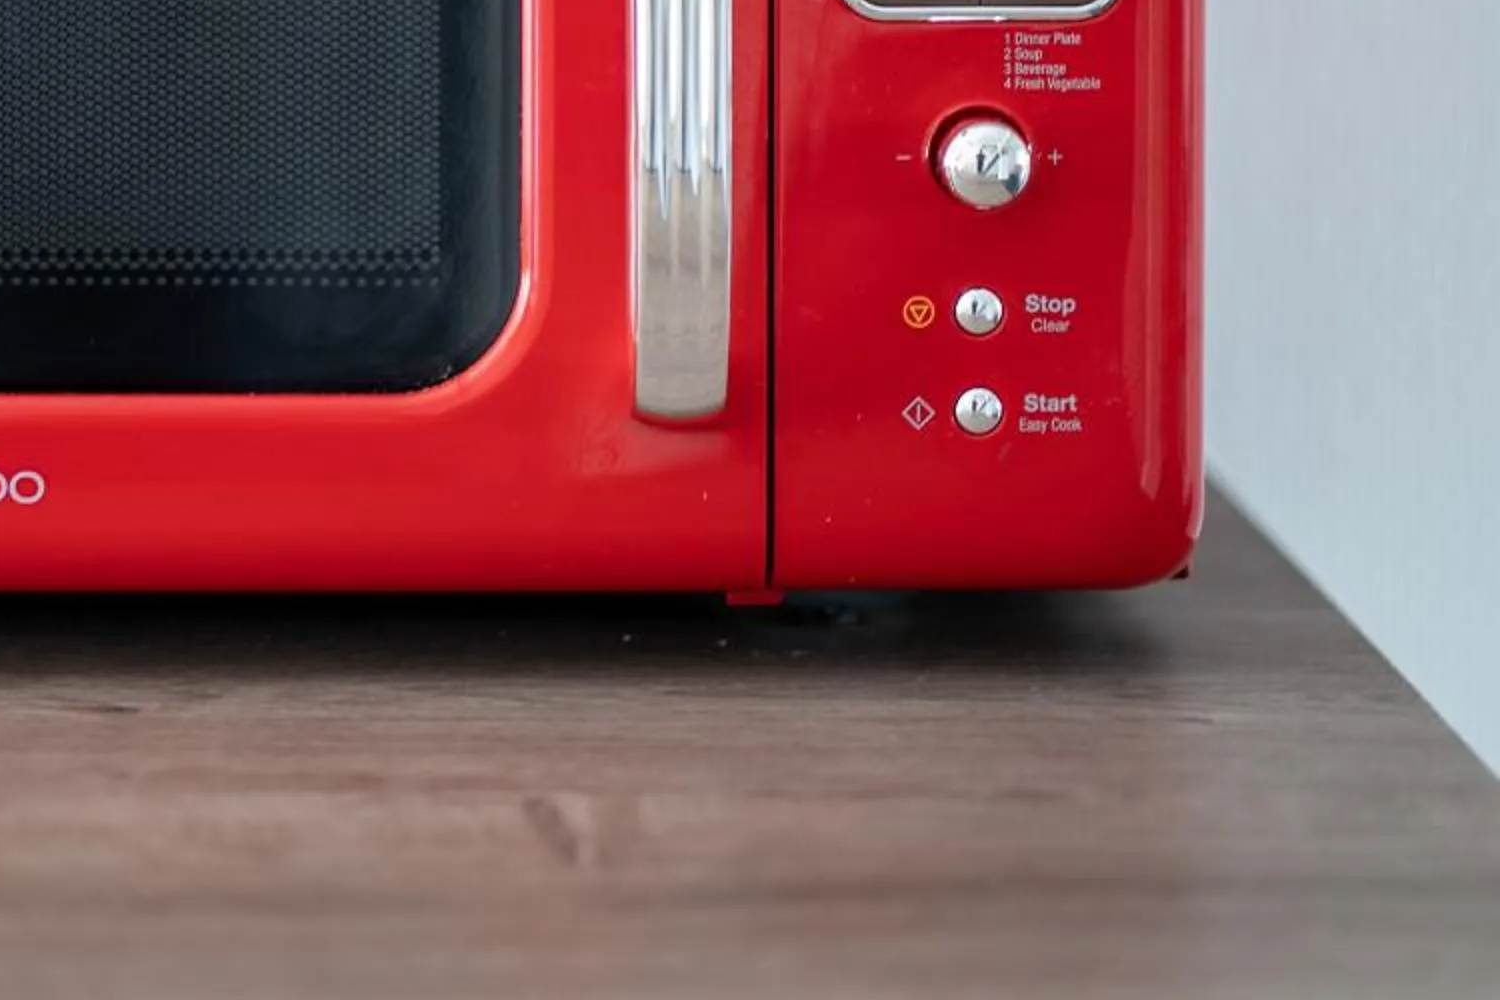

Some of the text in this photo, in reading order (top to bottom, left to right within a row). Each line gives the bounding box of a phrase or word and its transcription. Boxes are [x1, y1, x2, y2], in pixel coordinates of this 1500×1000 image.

[1015, 32, 1051, 45] Dinner
[1053, 32, 1082, 45] Plate
[1004, 47, 1043, 61] 2 Soup
[1004, 62, 1067, 76] 3 Beverage
[1004, 77, 1101, 93] 4 Fresh Vegetable
[1025, 294, 1076, 316] Stop
[1031, 318, 1069, 333] Clear
[1023, 393, 1077, 413] Start
[1019, 417, 1081, 434] Easy Cook
